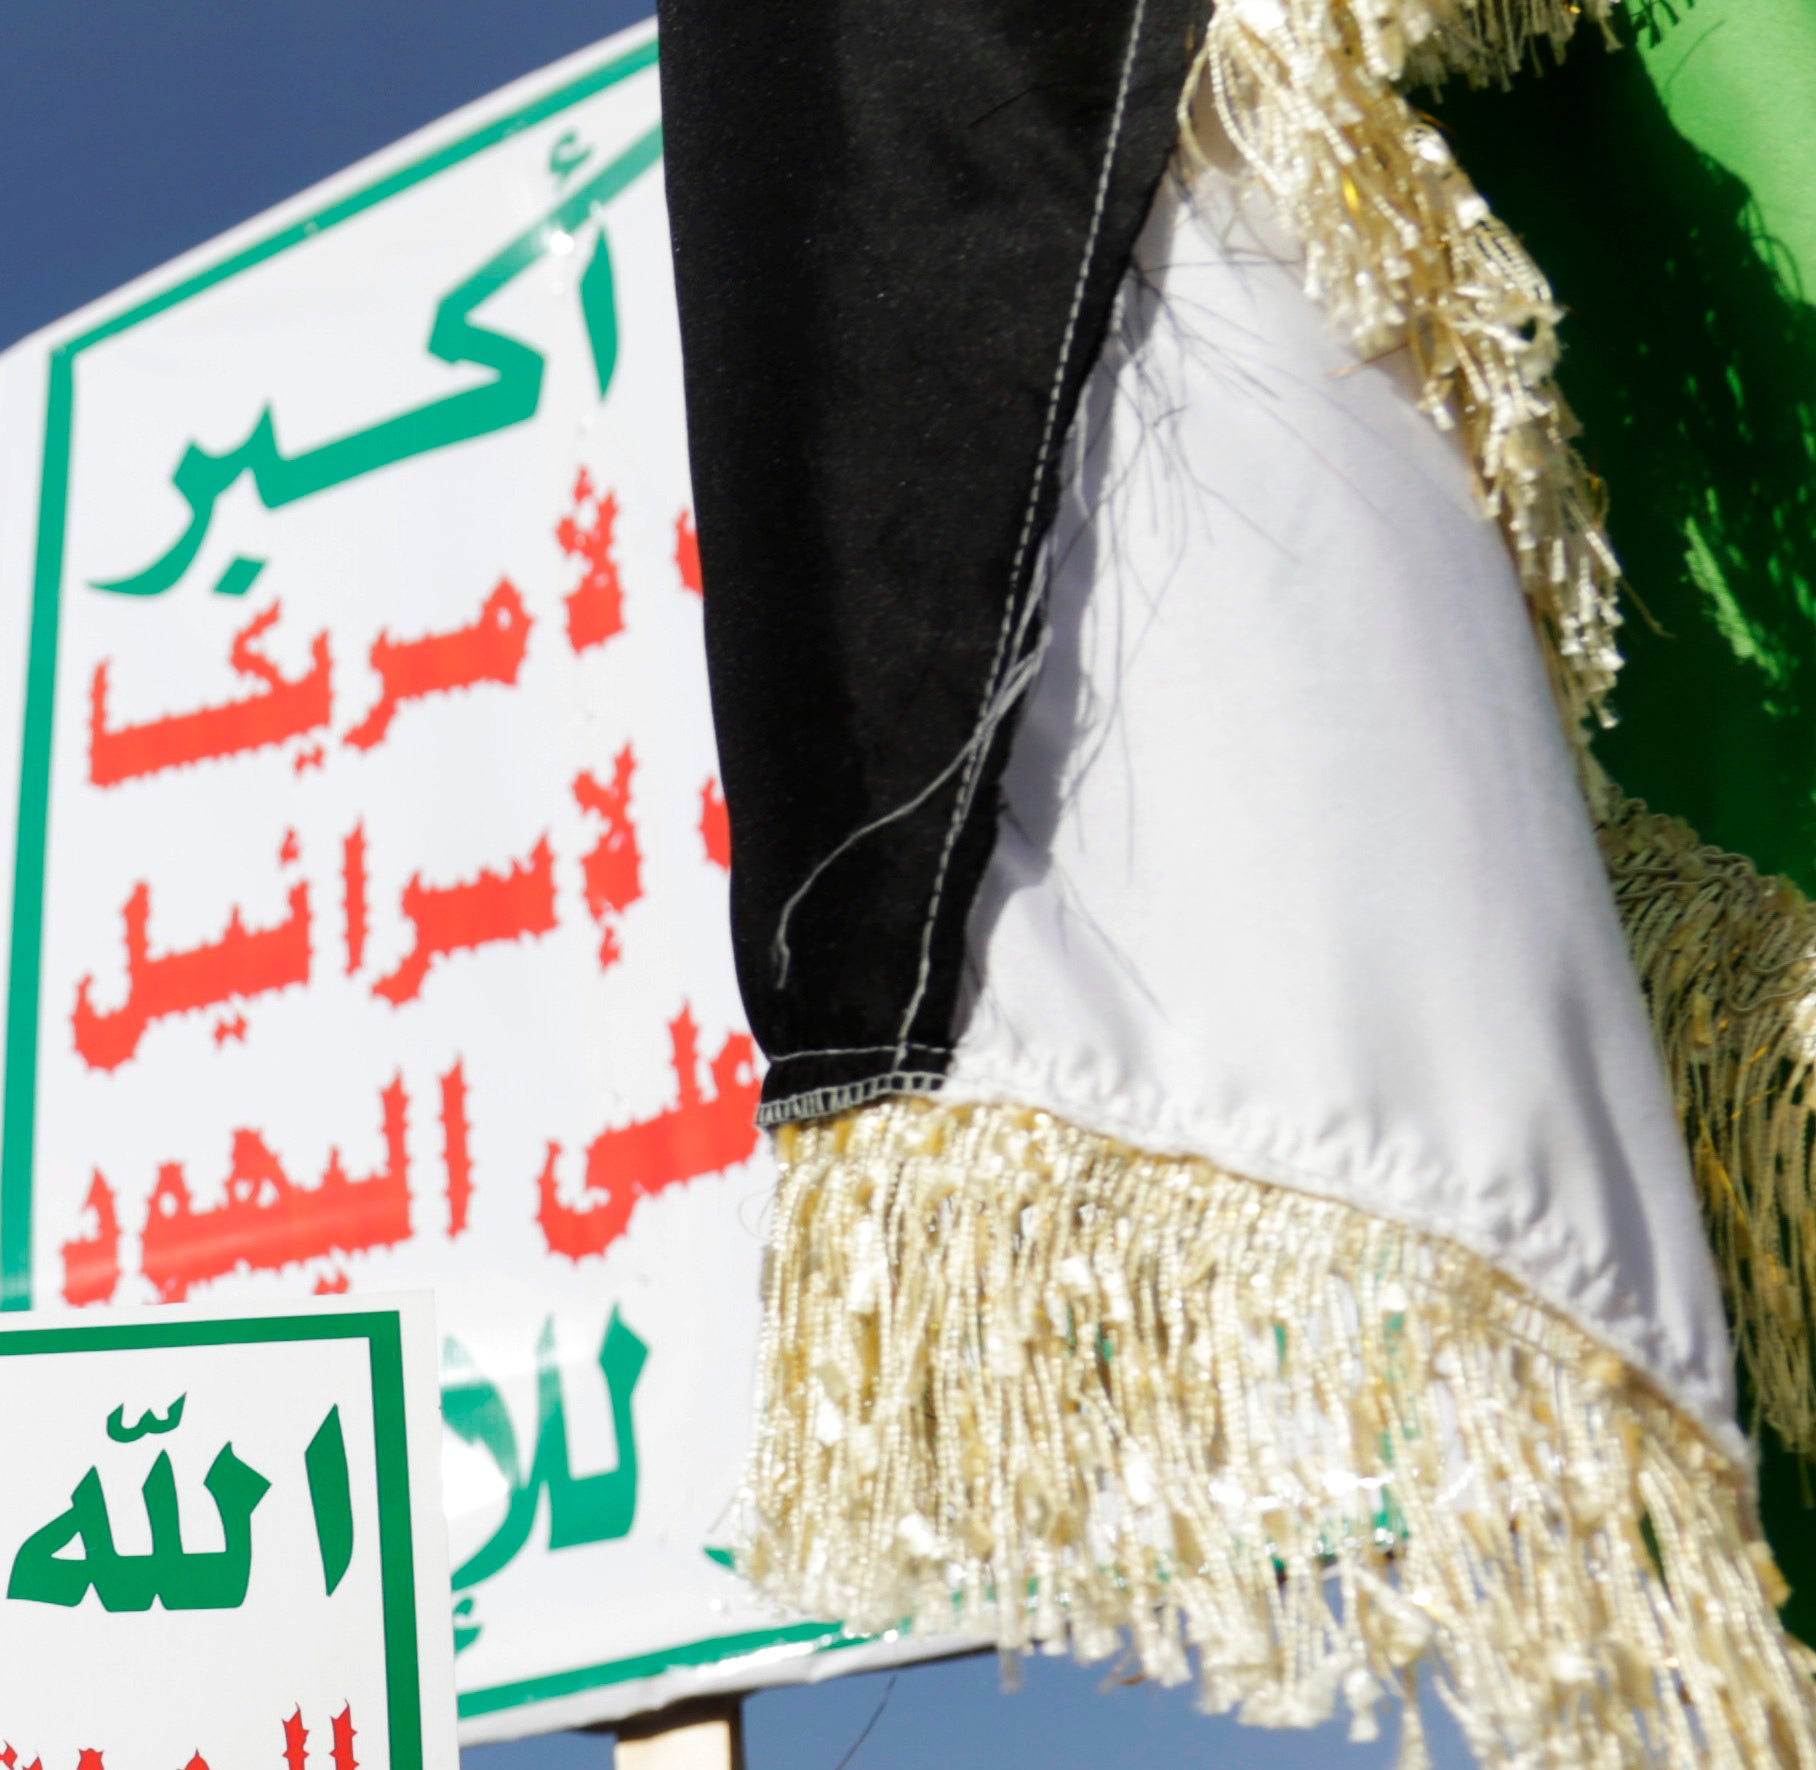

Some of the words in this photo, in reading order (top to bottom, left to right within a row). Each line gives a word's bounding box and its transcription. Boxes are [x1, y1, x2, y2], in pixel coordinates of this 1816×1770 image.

[86, 120, 664, 597] أكبر
[86, 462, 626, 791] لأمريكا
[60, 1050, 475, 1305] اليهود
[534, 997, 764, 1267] على
